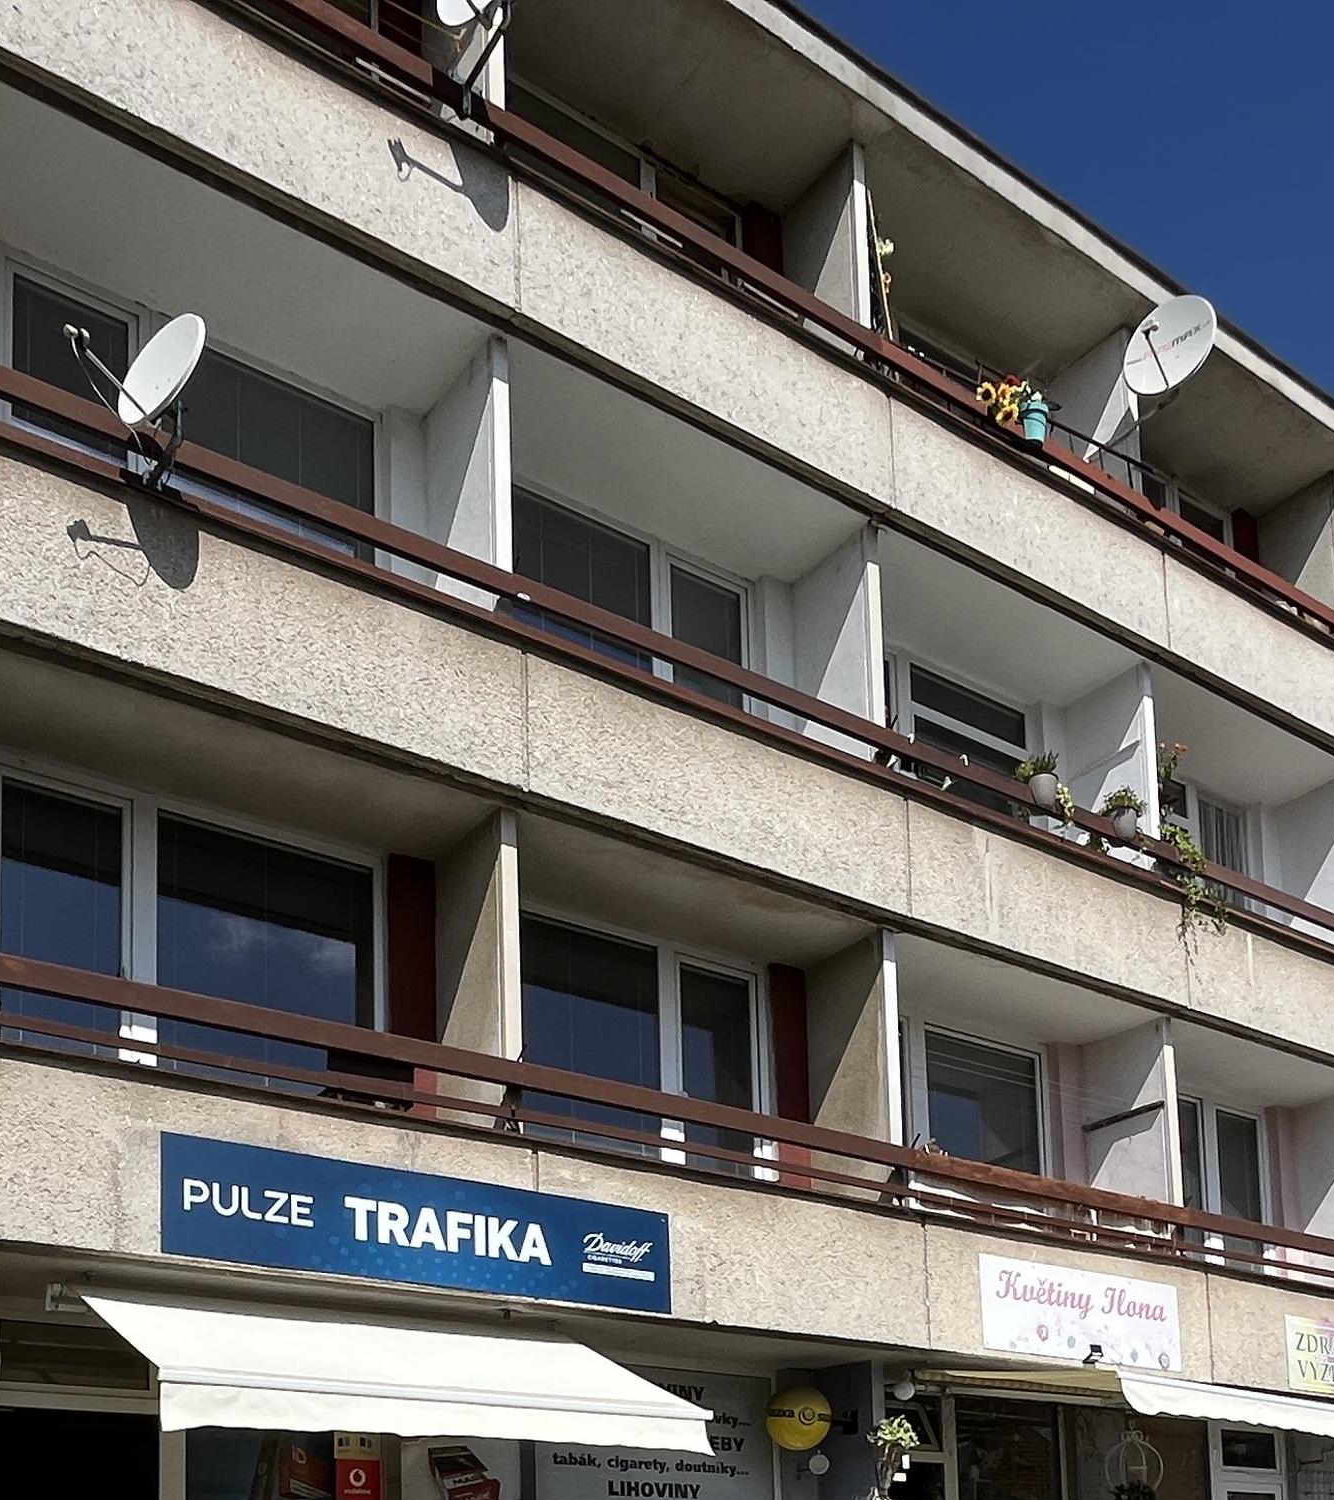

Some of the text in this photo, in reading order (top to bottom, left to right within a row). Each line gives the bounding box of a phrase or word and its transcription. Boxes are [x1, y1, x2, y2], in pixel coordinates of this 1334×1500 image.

[182, 1178, 552, 1267] PULZE TRAFIKA
[583, 1233, 653, 1263] Davidoff
[995, 1269, 1167, 1322] Květiny Ilona
[552, 1452, 750, 1477] tabák, cigarety, doutníky...
[608, 1480, 701, 1500] LIHOVINY
